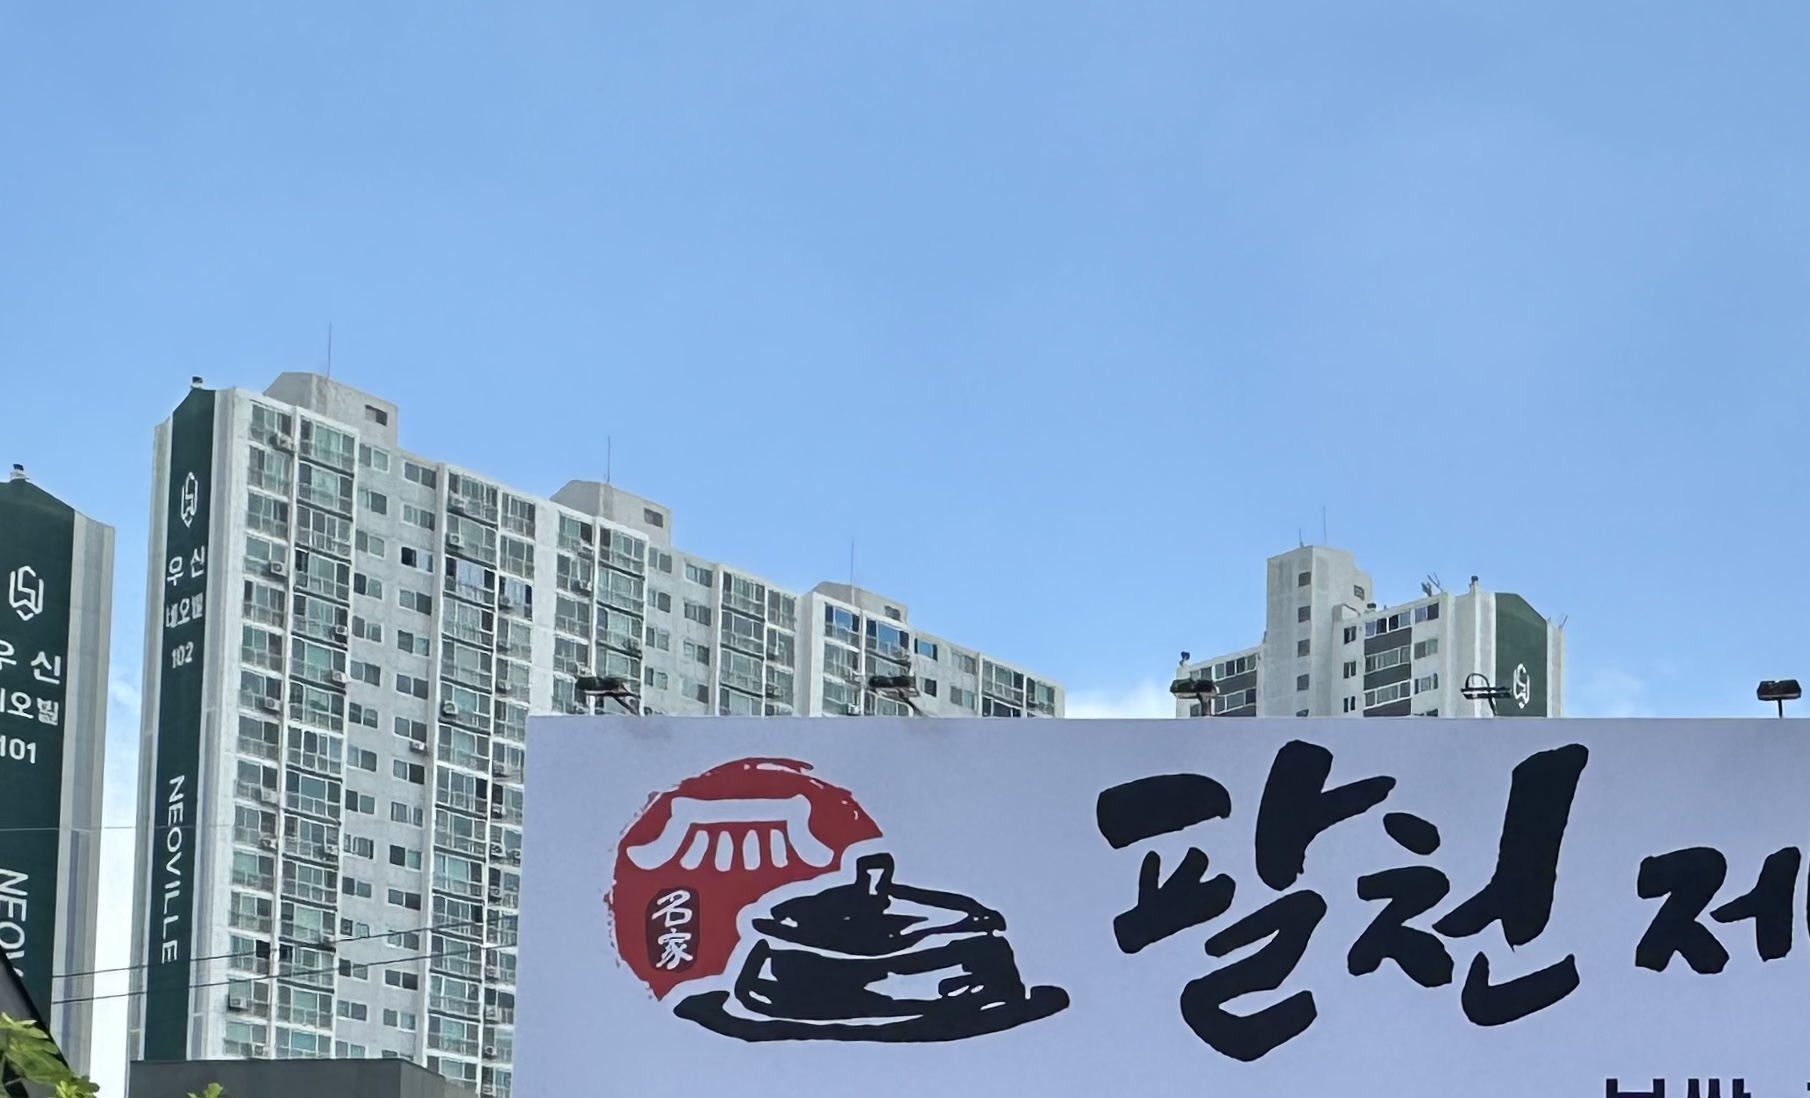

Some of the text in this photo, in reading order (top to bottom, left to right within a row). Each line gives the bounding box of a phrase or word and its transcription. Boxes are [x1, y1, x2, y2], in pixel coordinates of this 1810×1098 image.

[172, 641, 194, 669] 102
[0, 687, 60, 727] 오빌
[0, 735, 37, 764] 101
[161, 774, 186, 965] NEOVILLE
[651, 889, 694, 970] 名家
[1096, 739, 1589, 1062] 팔천
